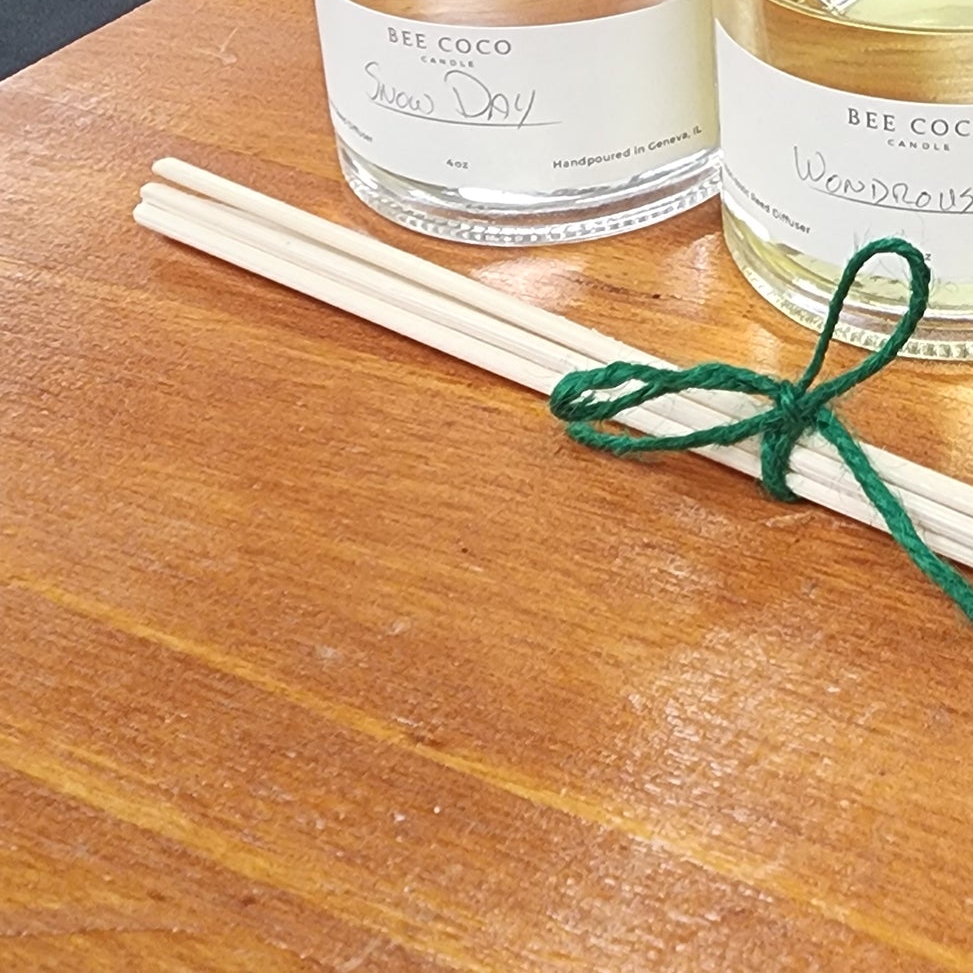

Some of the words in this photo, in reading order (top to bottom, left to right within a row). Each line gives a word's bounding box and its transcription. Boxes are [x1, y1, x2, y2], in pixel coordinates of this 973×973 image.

[388, 27, 427, 49] BEE
[438, 37, 512, 55] COCO
[420, 56, 475, 68] CANDLE
[848, 108, 896, 132] BEE
[552, 148, 631, 169] Handpoured
[634, 146, 645, 155] in
[648, 132, 691, 151] Geneva,
[887, 139, 950, 151] CANDLE
[446, 159, 469, 170] 4oz
[772, 208, 811, 234] Diffuser
